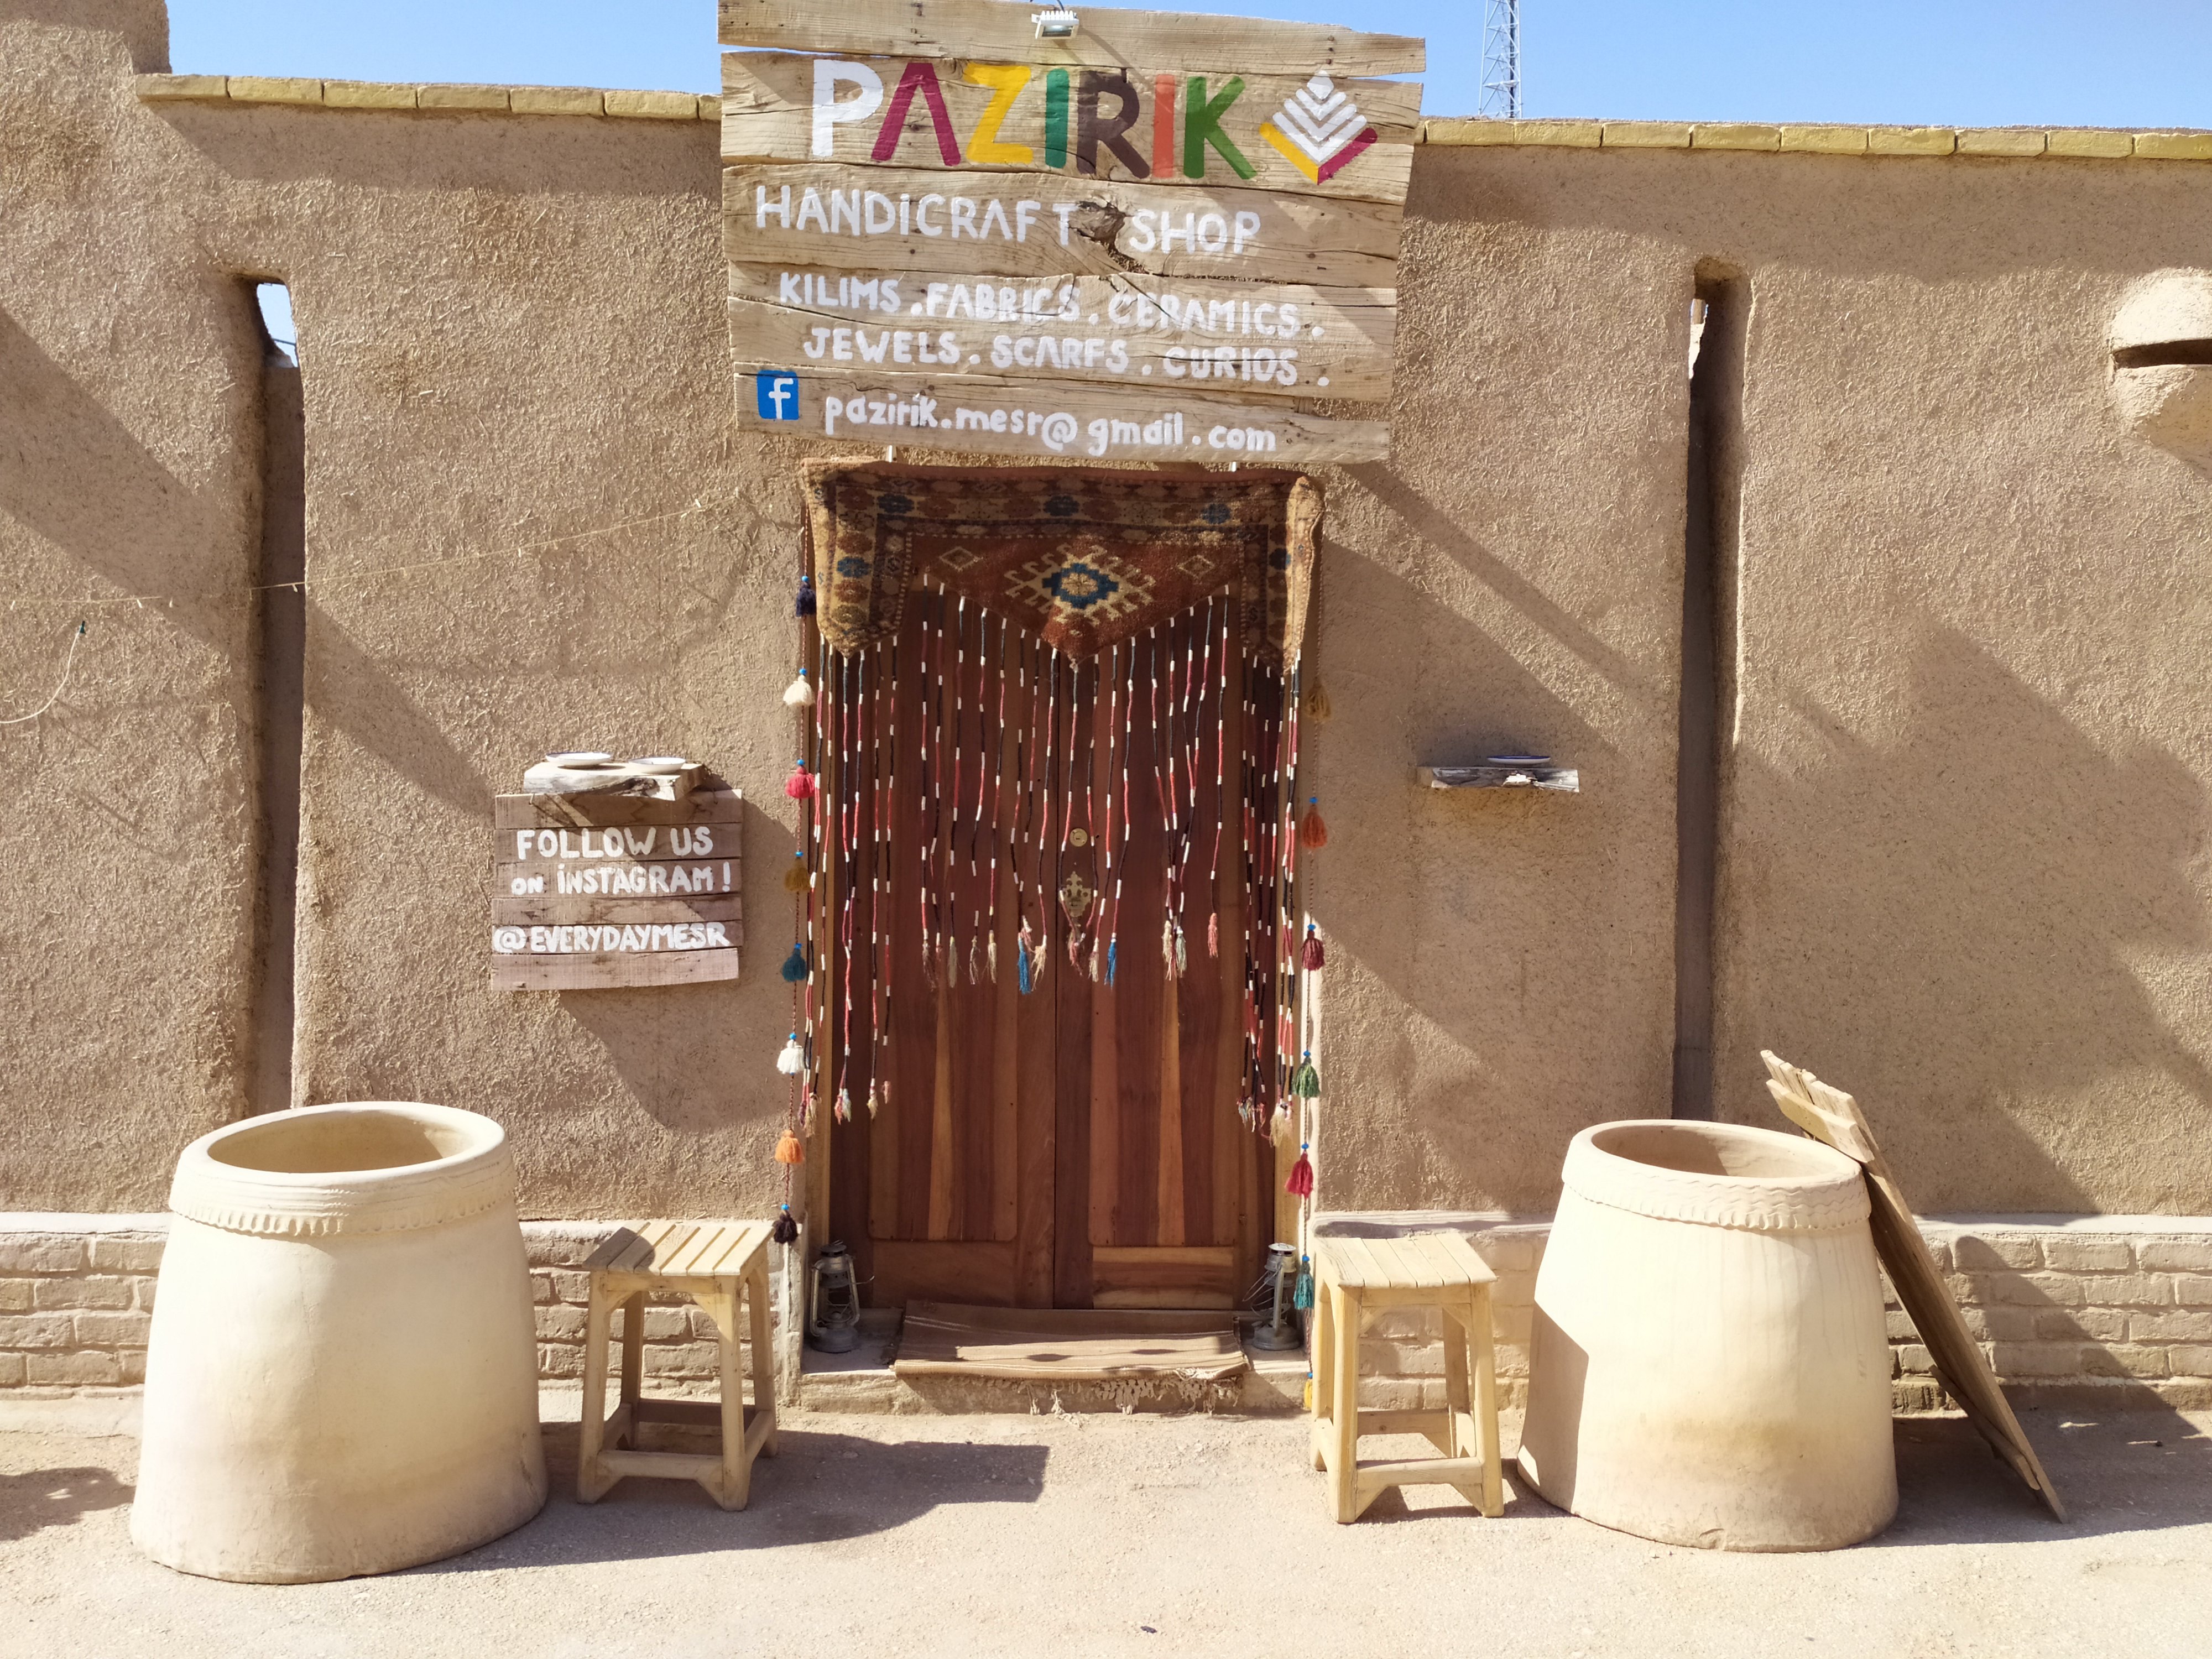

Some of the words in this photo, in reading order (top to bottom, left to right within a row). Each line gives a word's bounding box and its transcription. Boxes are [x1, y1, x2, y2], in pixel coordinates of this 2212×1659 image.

[812, 58, 1258, 180] PAZIRIK
[1129, 208, 1261, 254] SHOP
[517, 826, 656, 860] FOLLOW
[670, 826, 714, 857] US
[492, 921, 732, 953] @EVERYDAYMESR
